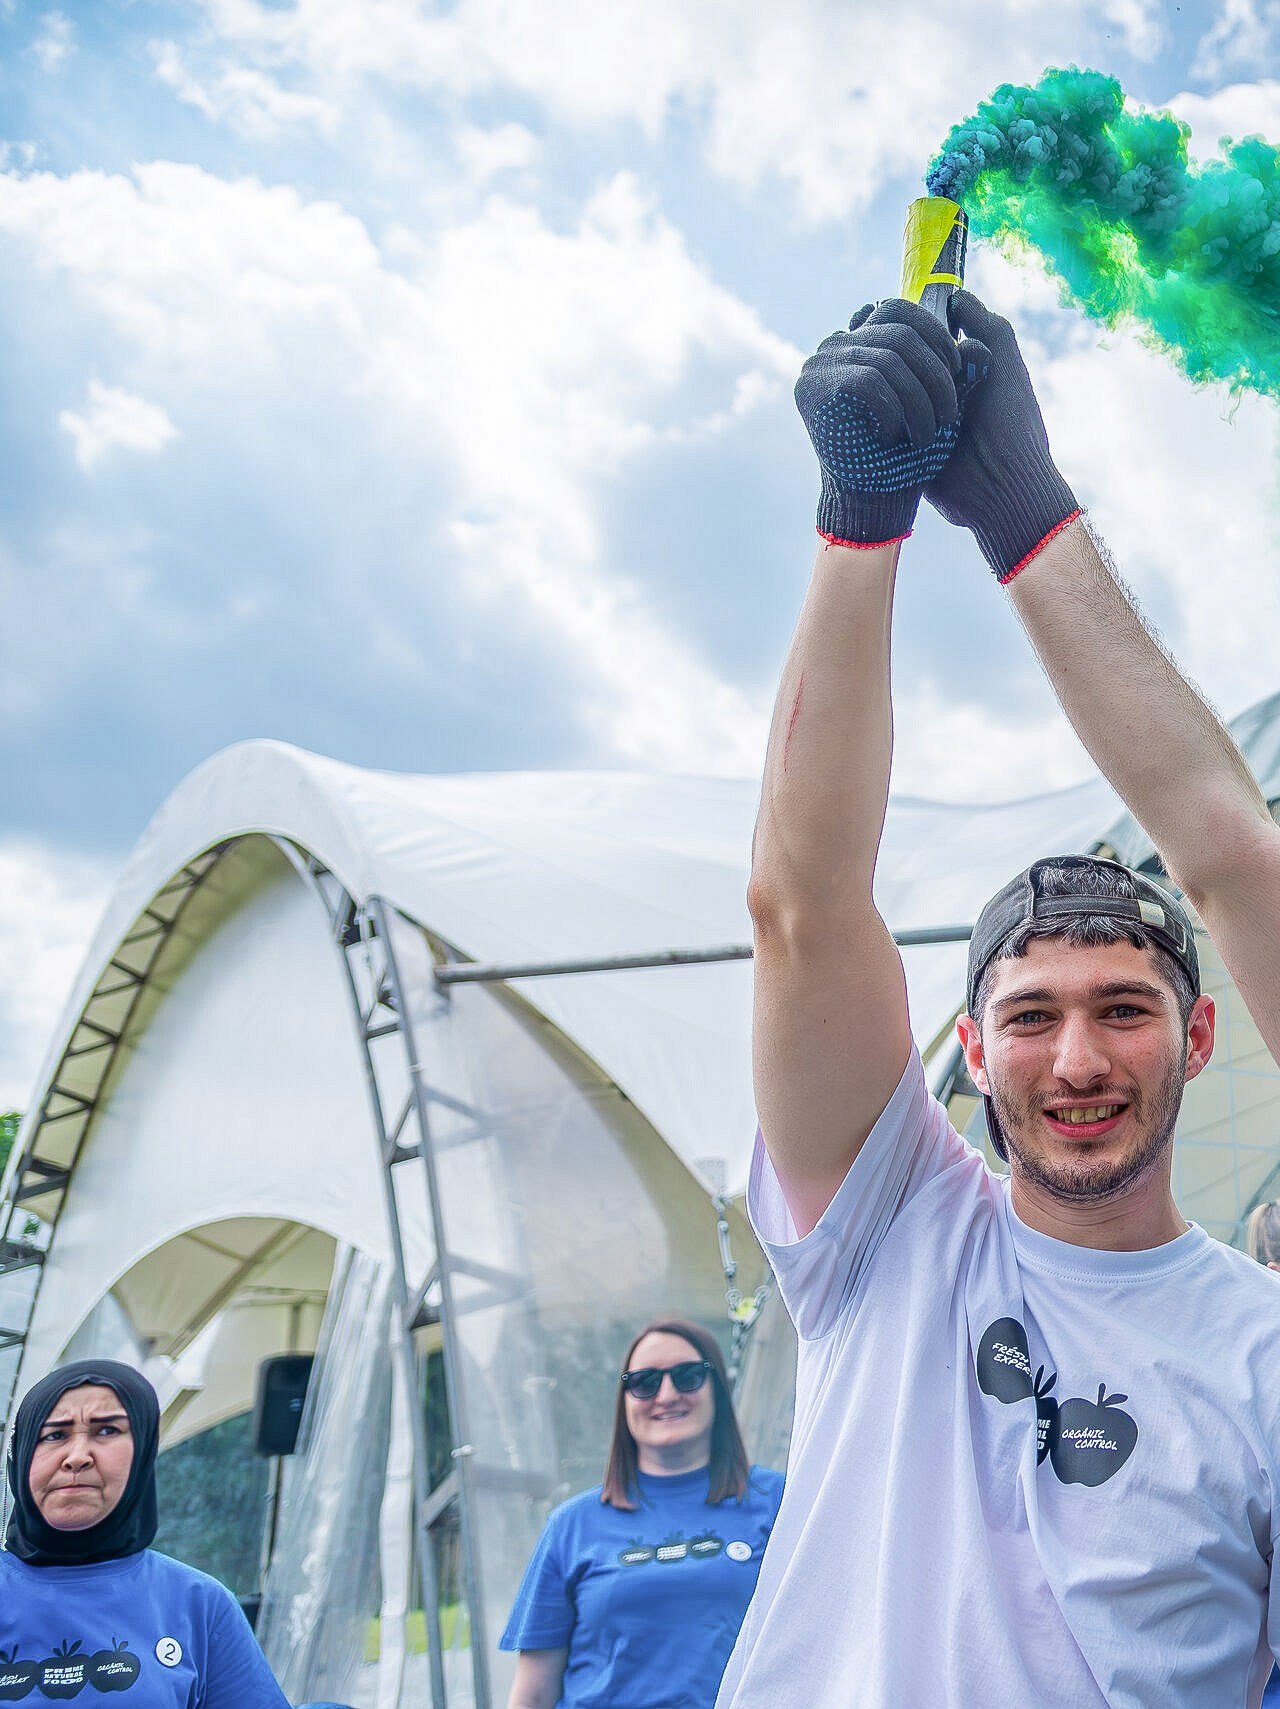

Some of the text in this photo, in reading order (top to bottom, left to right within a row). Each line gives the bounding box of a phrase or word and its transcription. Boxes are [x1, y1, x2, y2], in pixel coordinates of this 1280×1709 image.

[993, 1353, 1032, 1377] EXPER
[1074, 1438, 1118, 1451] CONTROL
[163, 1642, 176, 1661] 2
[43, 1676, 84, 1685] FOOD
[44, 1671, 84, 1679] NATURAL
